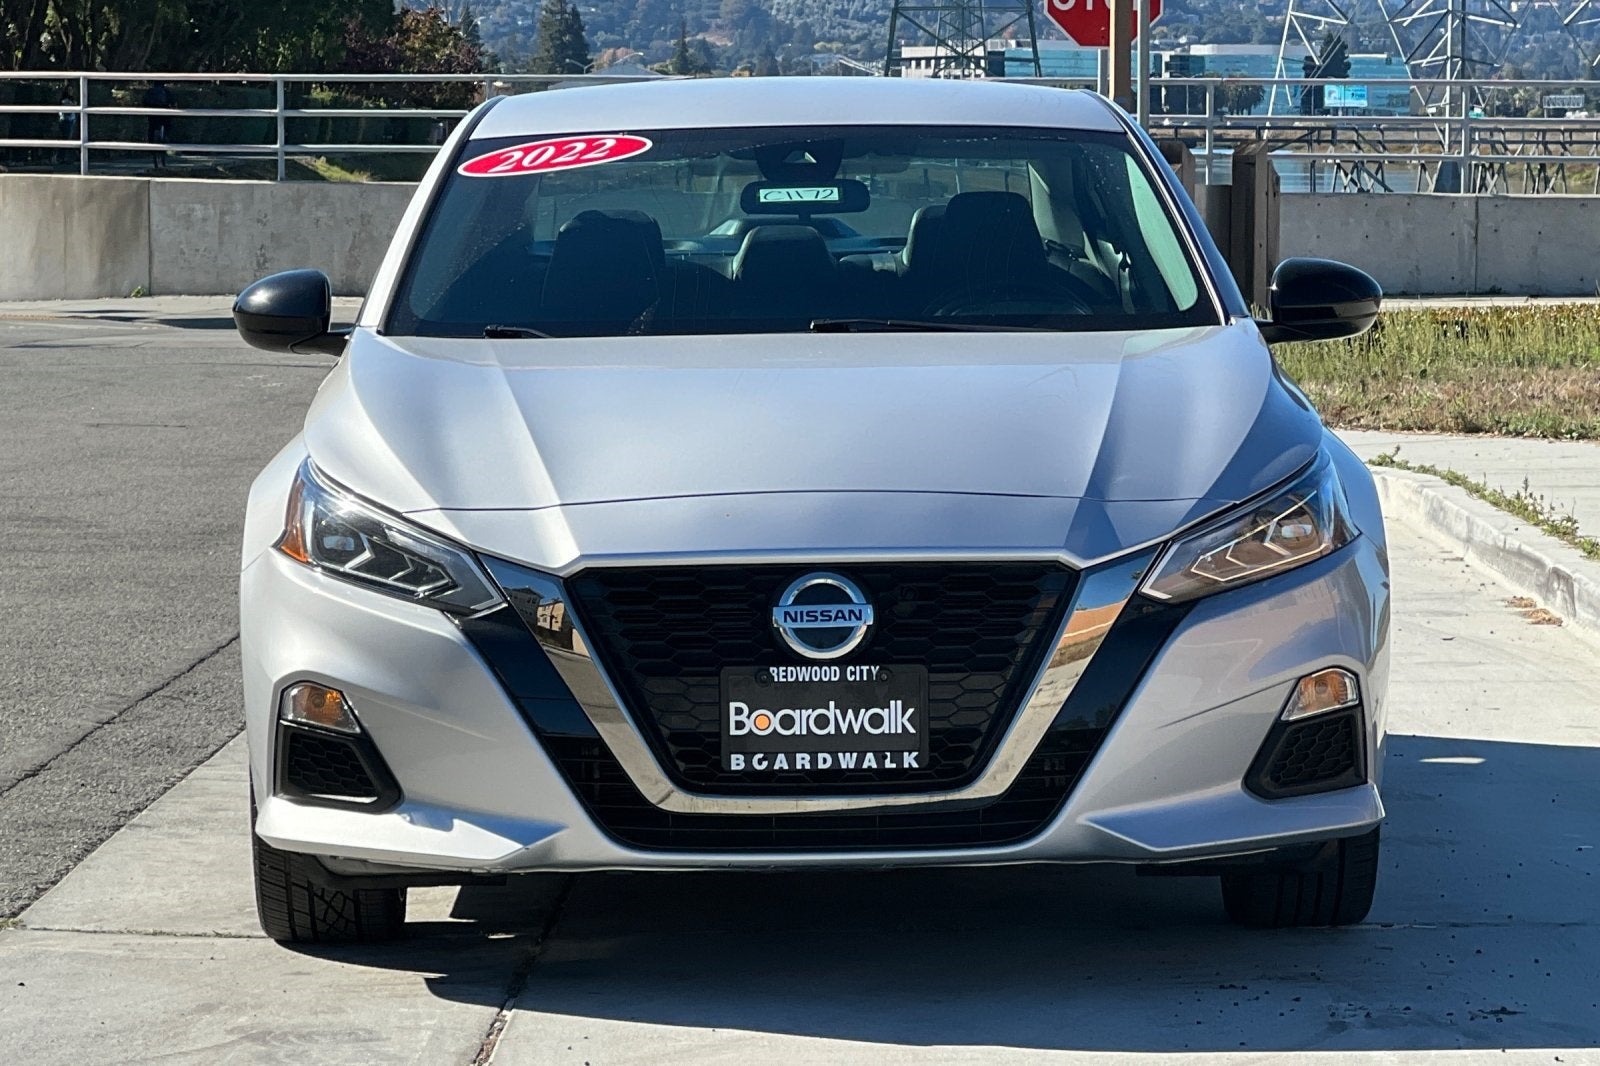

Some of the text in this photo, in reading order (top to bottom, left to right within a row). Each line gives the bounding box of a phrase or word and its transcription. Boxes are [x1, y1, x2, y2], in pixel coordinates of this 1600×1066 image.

[487, 138, 617, 174] 2022
[783, 608, 863, 624] NISSAN
[769, 665, 880, 682] REDWOOD CITY
[729, 700, 917, 736] Boardwalk
[730, 751, 919, 771] BOARDWALK
